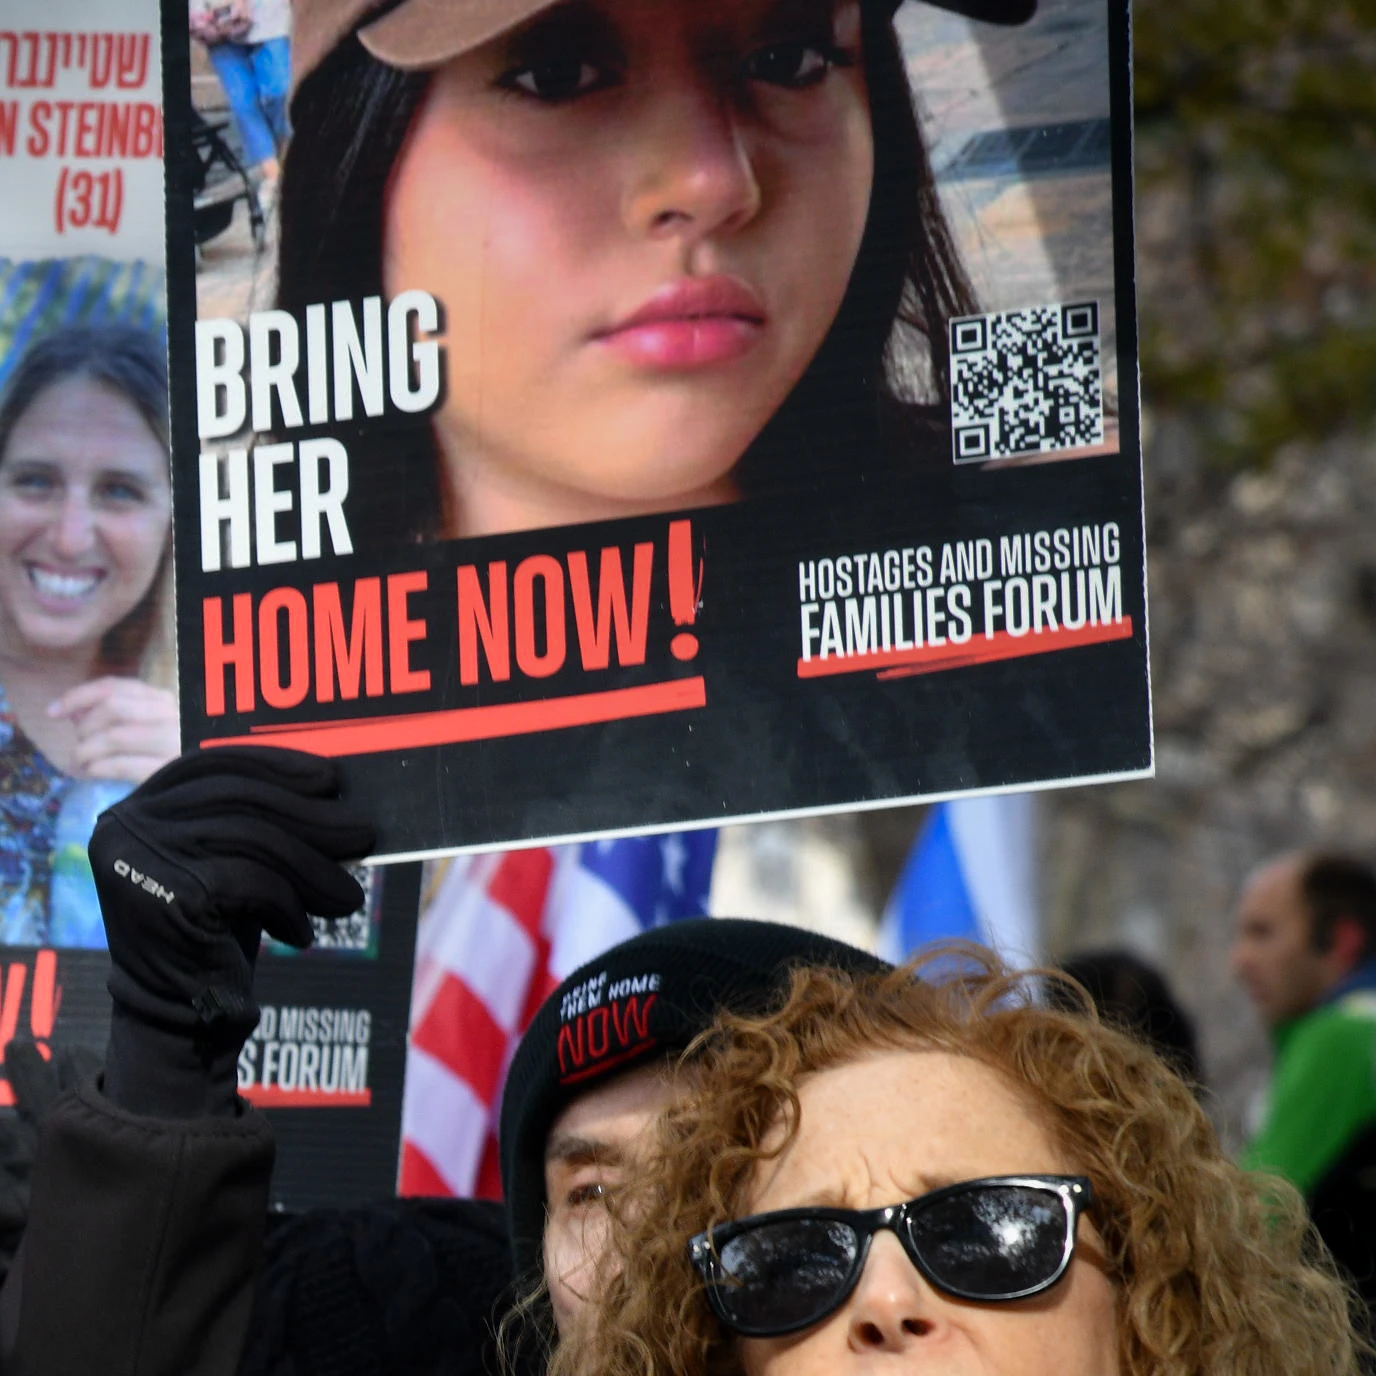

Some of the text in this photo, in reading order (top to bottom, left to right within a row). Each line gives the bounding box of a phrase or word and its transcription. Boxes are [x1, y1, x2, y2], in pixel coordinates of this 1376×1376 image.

[26, 100, 164, 159] STEINB
[55, 167, 125, 234] (31)
[194, 290, 445, 440] BRING
[198, 438, 354, 572] HER
[798, 522, 1121, 601] HOSTAGES AND MISSING
[202, 519, 706, 716] HOME NOW!
[800, 565, 1123, 662] FAMILIES FORUM
[113, 858, 175, 905] HEAD
[279, 1006, 371, 1043] MISSING
[556, 993, 658, 1074] NOW
[261, 1040, 369, 1094] FORUM
